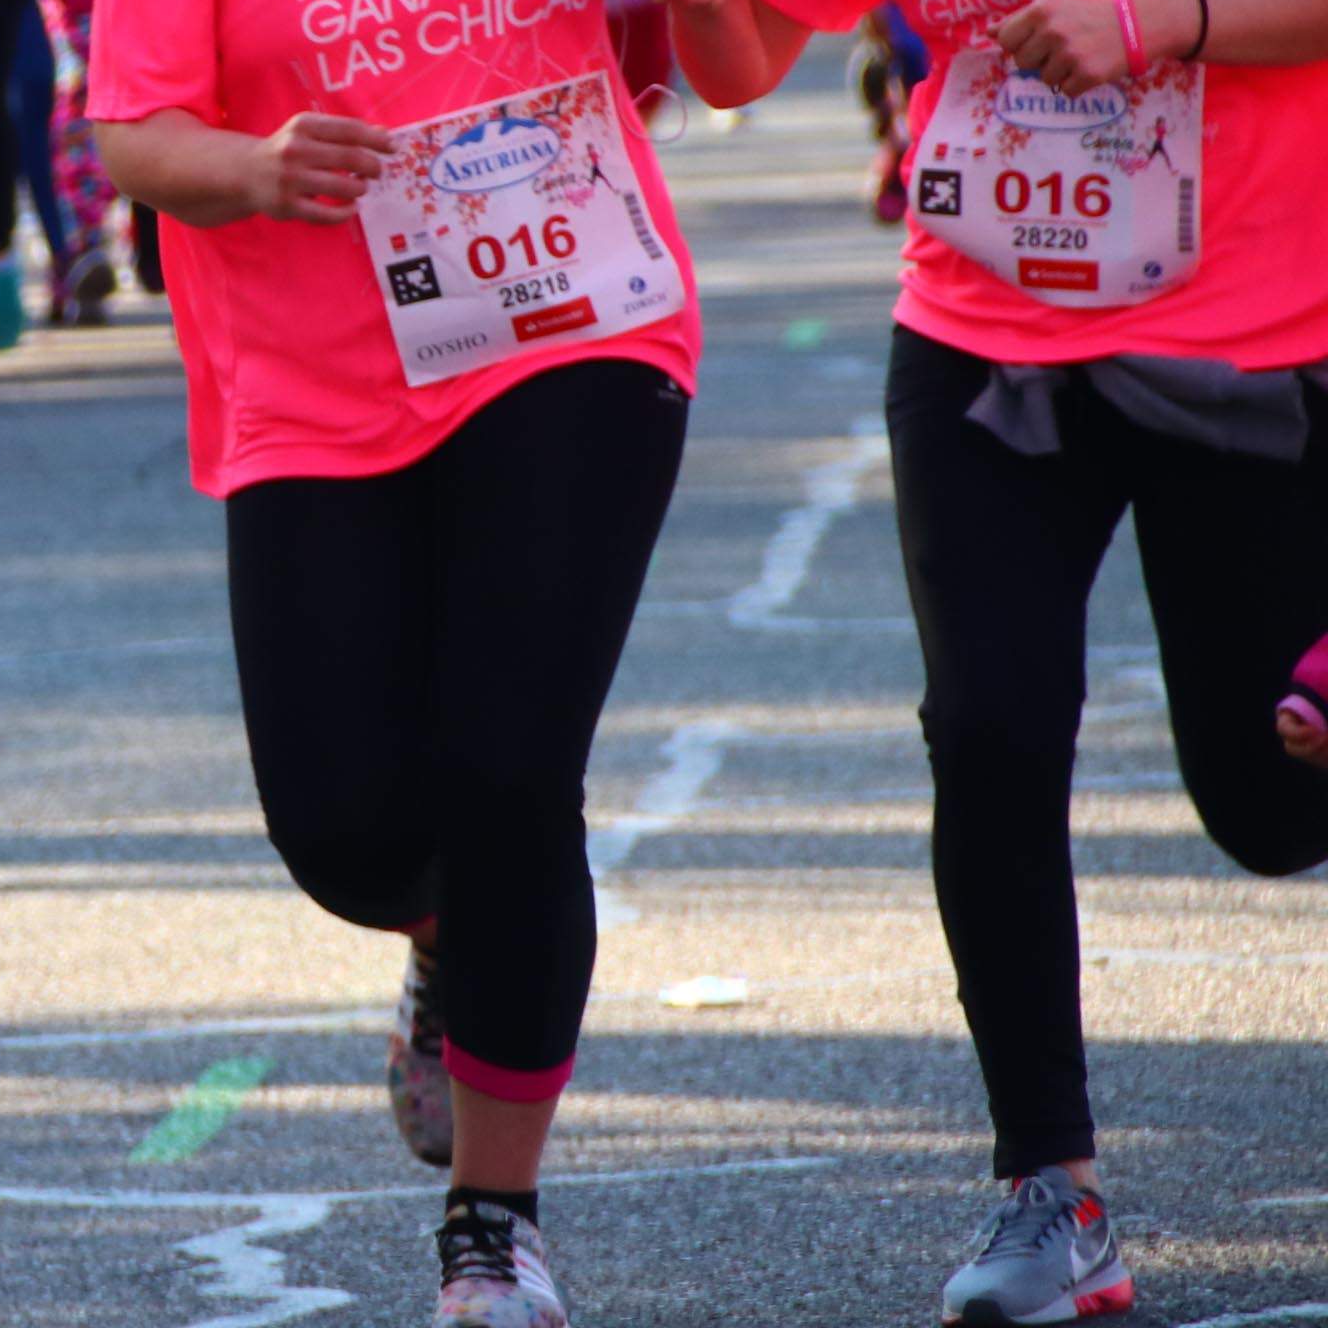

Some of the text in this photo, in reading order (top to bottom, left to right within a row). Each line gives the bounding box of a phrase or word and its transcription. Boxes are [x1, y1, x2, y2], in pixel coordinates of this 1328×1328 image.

[316, 28, 405, 93] LAS
[1001, 89, 1117, 115] ASTURIANA
[443, 140, 554, 186] ASTURIANA
[994, 169, 1112, 218] 016
[466, 214, 576, 281] 016
[1012, 225, 1089, 250] 28220
[499, 271, 570, 308] 28218
[416, 332, 488, 362] OYSHO
